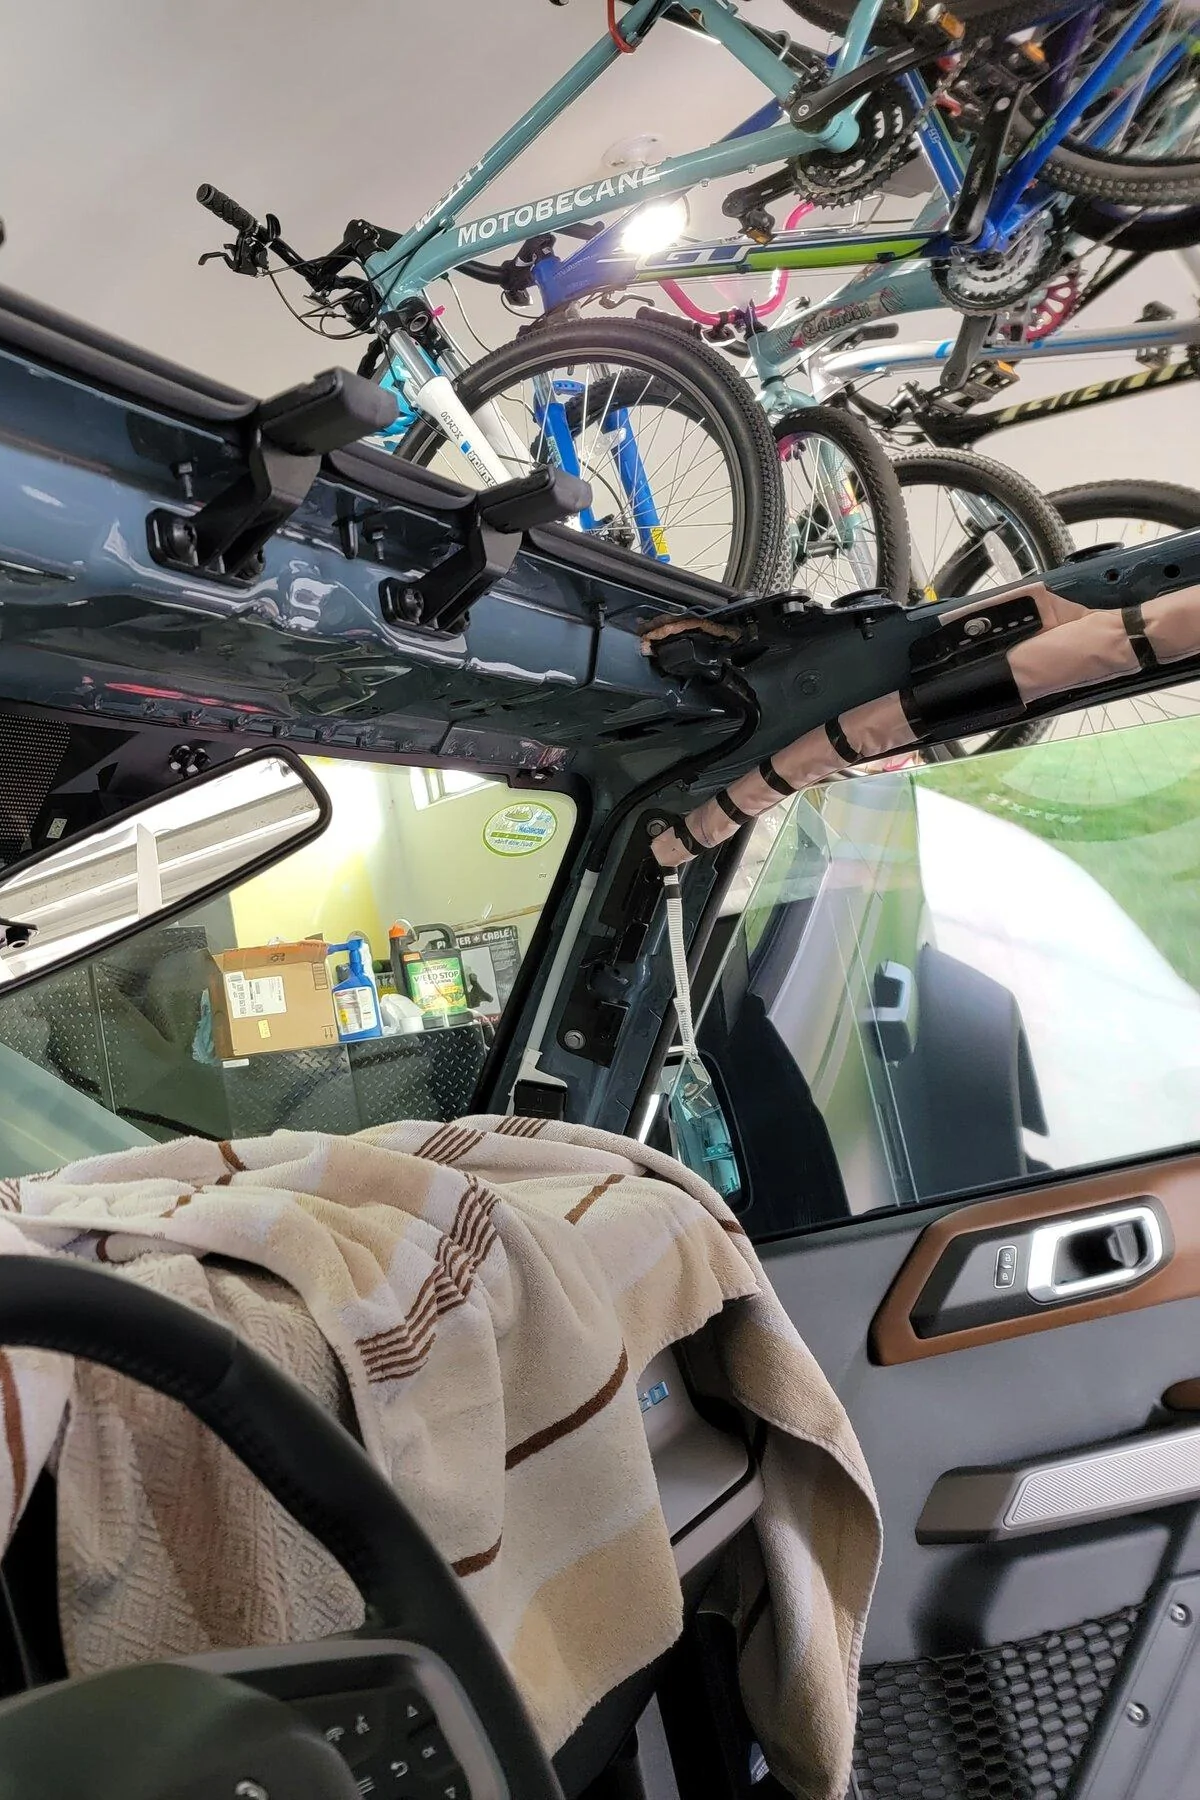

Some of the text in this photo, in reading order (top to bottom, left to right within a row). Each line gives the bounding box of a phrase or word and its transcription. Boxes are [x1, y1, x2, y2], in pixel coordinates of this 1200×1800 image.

[457, 163, 662, 248] MOTOBECANE
[440, 411, 464, 440] XCM30
[482, 928, 510, 941] CABLE
